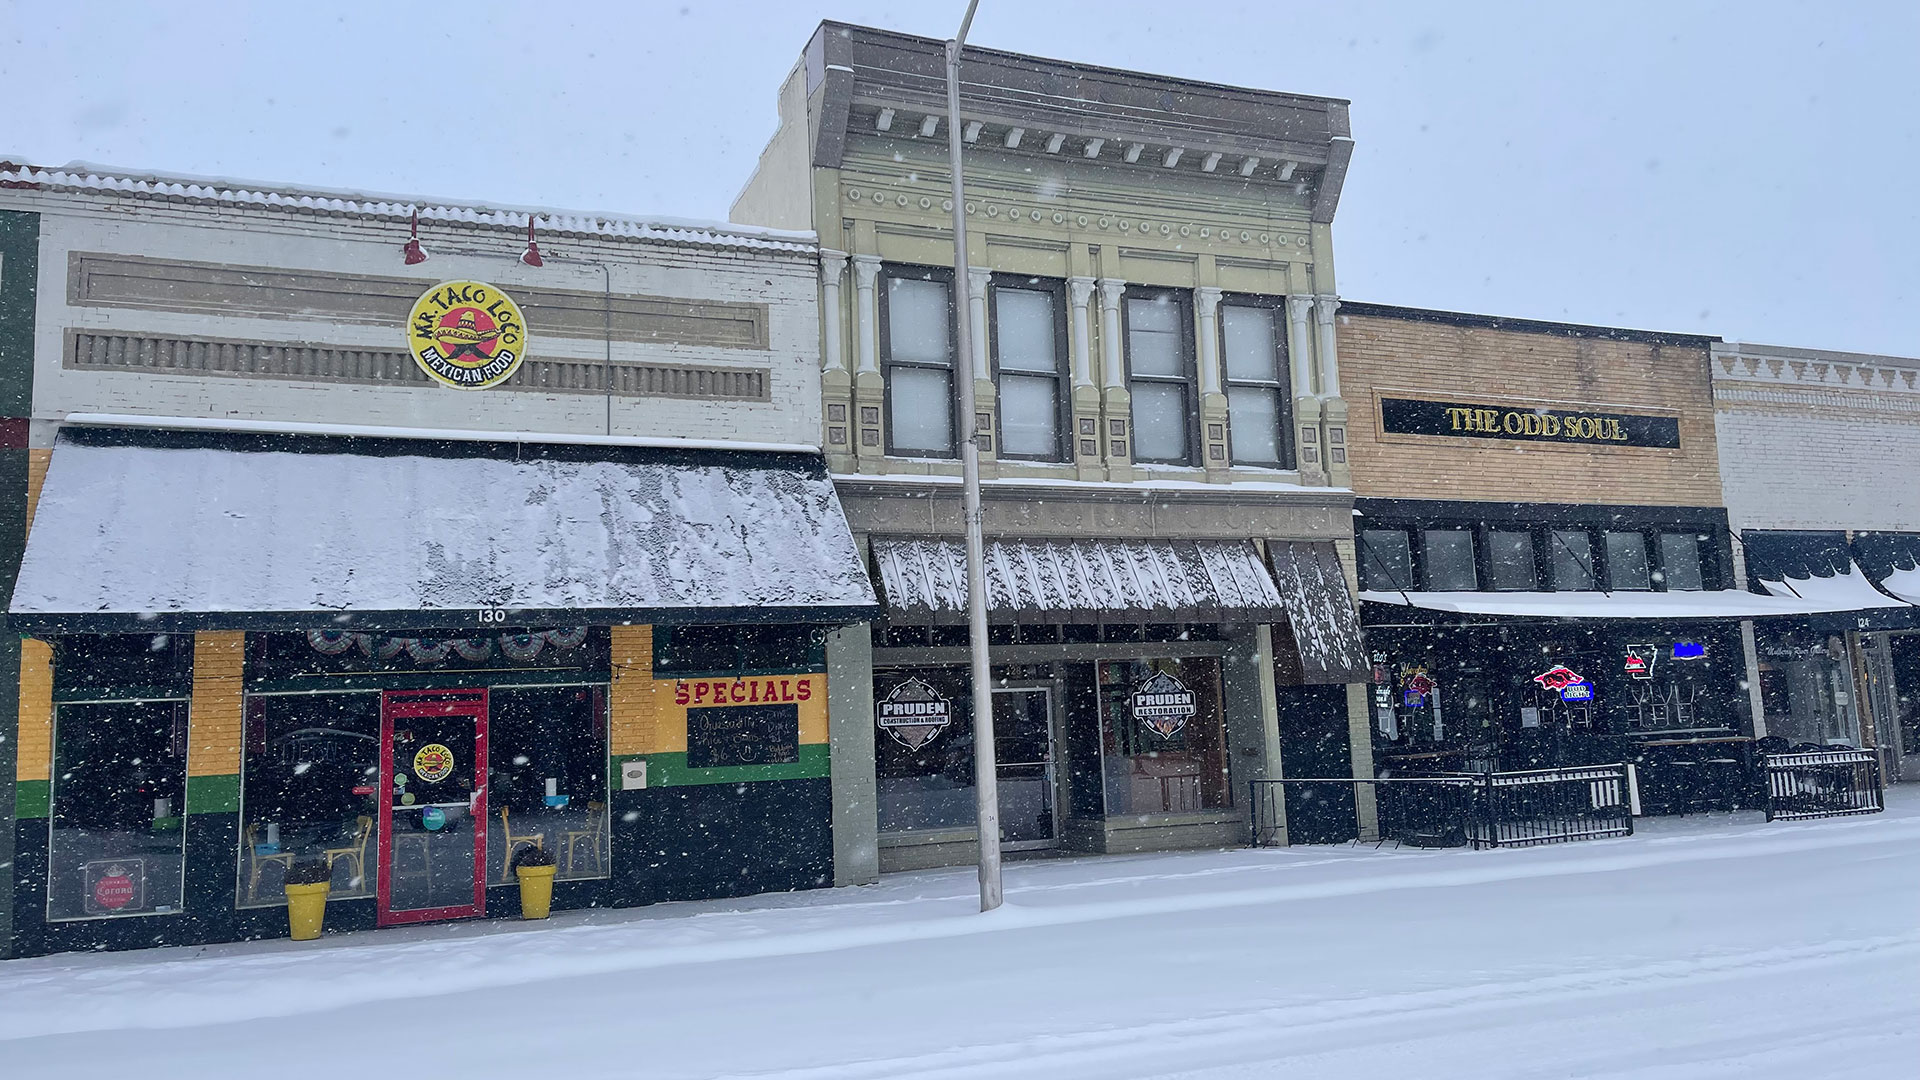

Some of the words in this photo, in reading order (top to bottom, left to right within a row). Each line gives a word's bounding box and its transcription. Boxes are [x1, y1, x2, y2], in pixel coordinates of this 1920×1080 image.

[414, 311, 438, 340] MR.
[429, 285, 486, 310] TACO
[486, 300, 520, 344] LOCO
[422, 348, 484, 382] MEXICAN
[483, 350, 514, 379] FOOD
[1446, 407, 1500, 433] THE
[1503, 411, 1561, 437] ODD
[1564, 415, 1627, 441] SOUL
[478, 609, 506, 623] 130
[1857, 617, 1870, 628] 124
[675, 679, 812, 706] SPECIALS
[1136, 693, 1192, 707] PRUDEN
[883, 702, 946, 716] PRUDEN
[1138, 706, 1192, 716] RESTORATION
[421, 745, 441, 756] TACO
[97, 886, 134, 897] Corona
